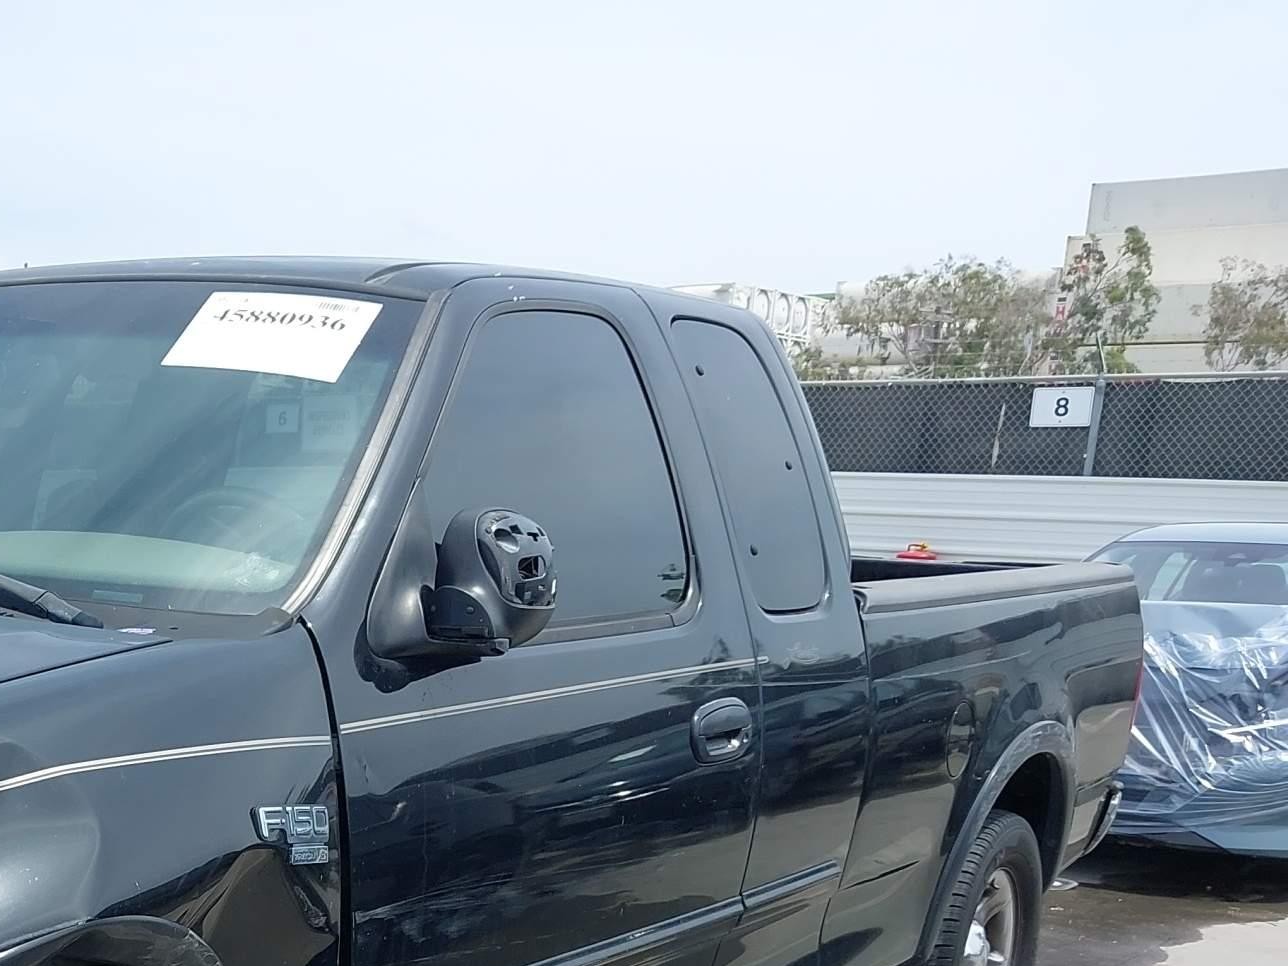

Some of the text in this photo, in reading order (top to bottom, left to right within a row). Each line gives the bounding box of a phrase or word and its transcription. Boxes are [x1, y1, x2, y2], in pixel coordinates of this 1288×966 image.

[213, 308, 347, 333] 45880936
[1054, 397, 1070, 417] 8
[278, 411, 288, 426] 6
